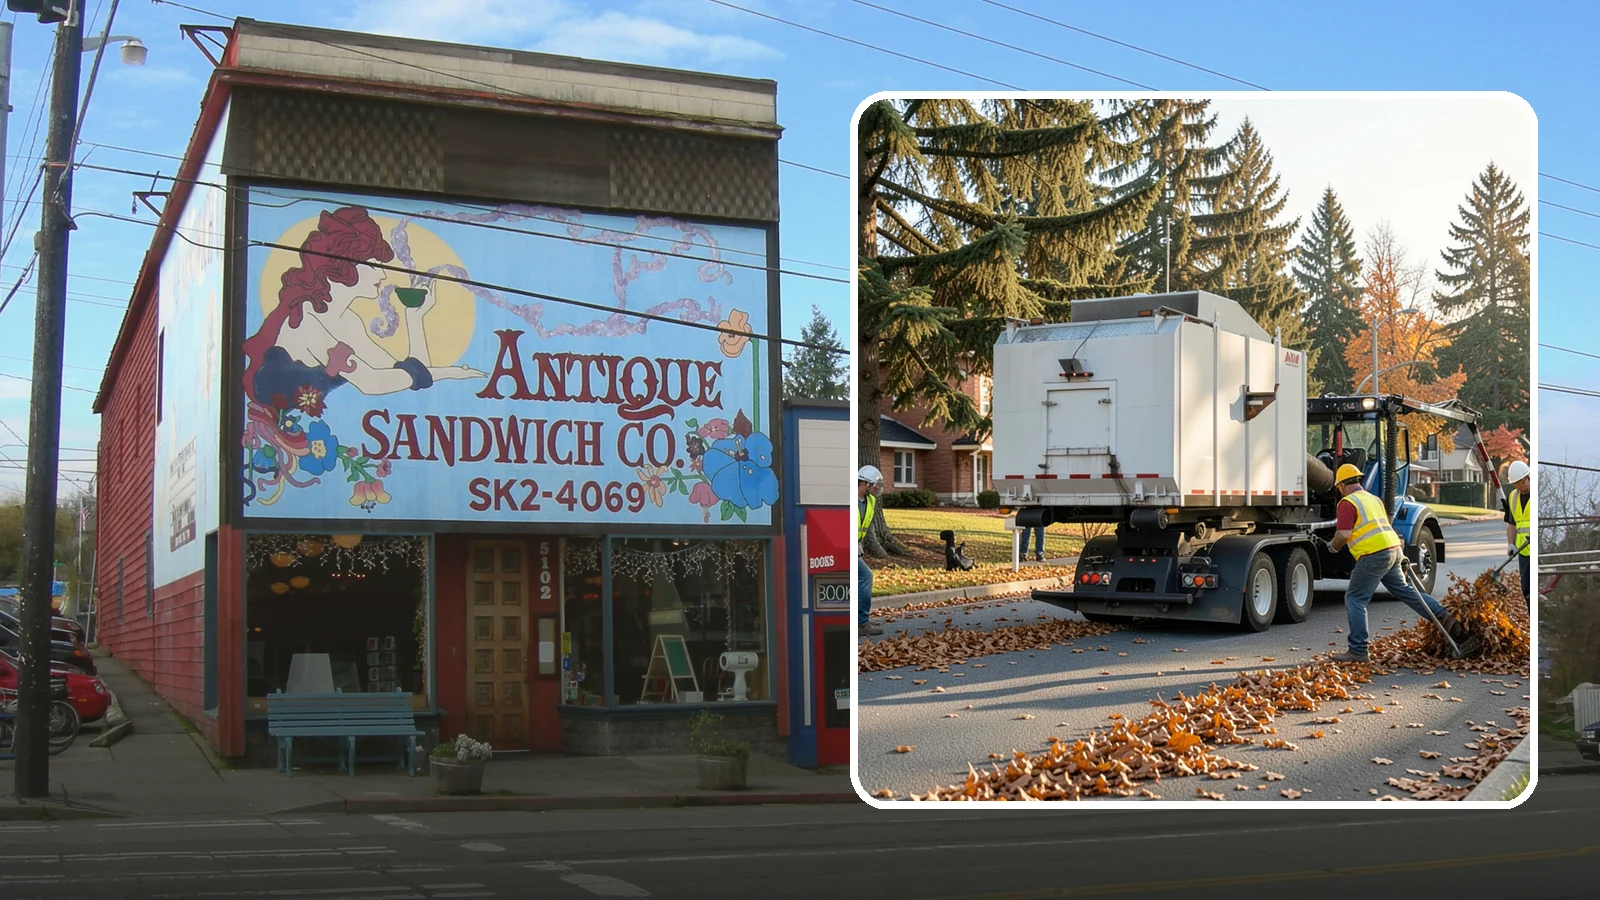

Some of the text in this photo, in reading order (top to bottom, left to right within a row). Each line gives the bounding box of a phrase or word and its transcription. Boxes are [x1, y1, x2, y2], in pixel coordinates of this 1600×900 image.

[475, 328, 723, 421] ANTIQUE
[361, 408, 684, 469] SANDWICH CO.
[468, 477, 646, 513] SK2-4069
[540, 541, 552, 600] 5102
[809, 555, 835, 569] BOOKS
